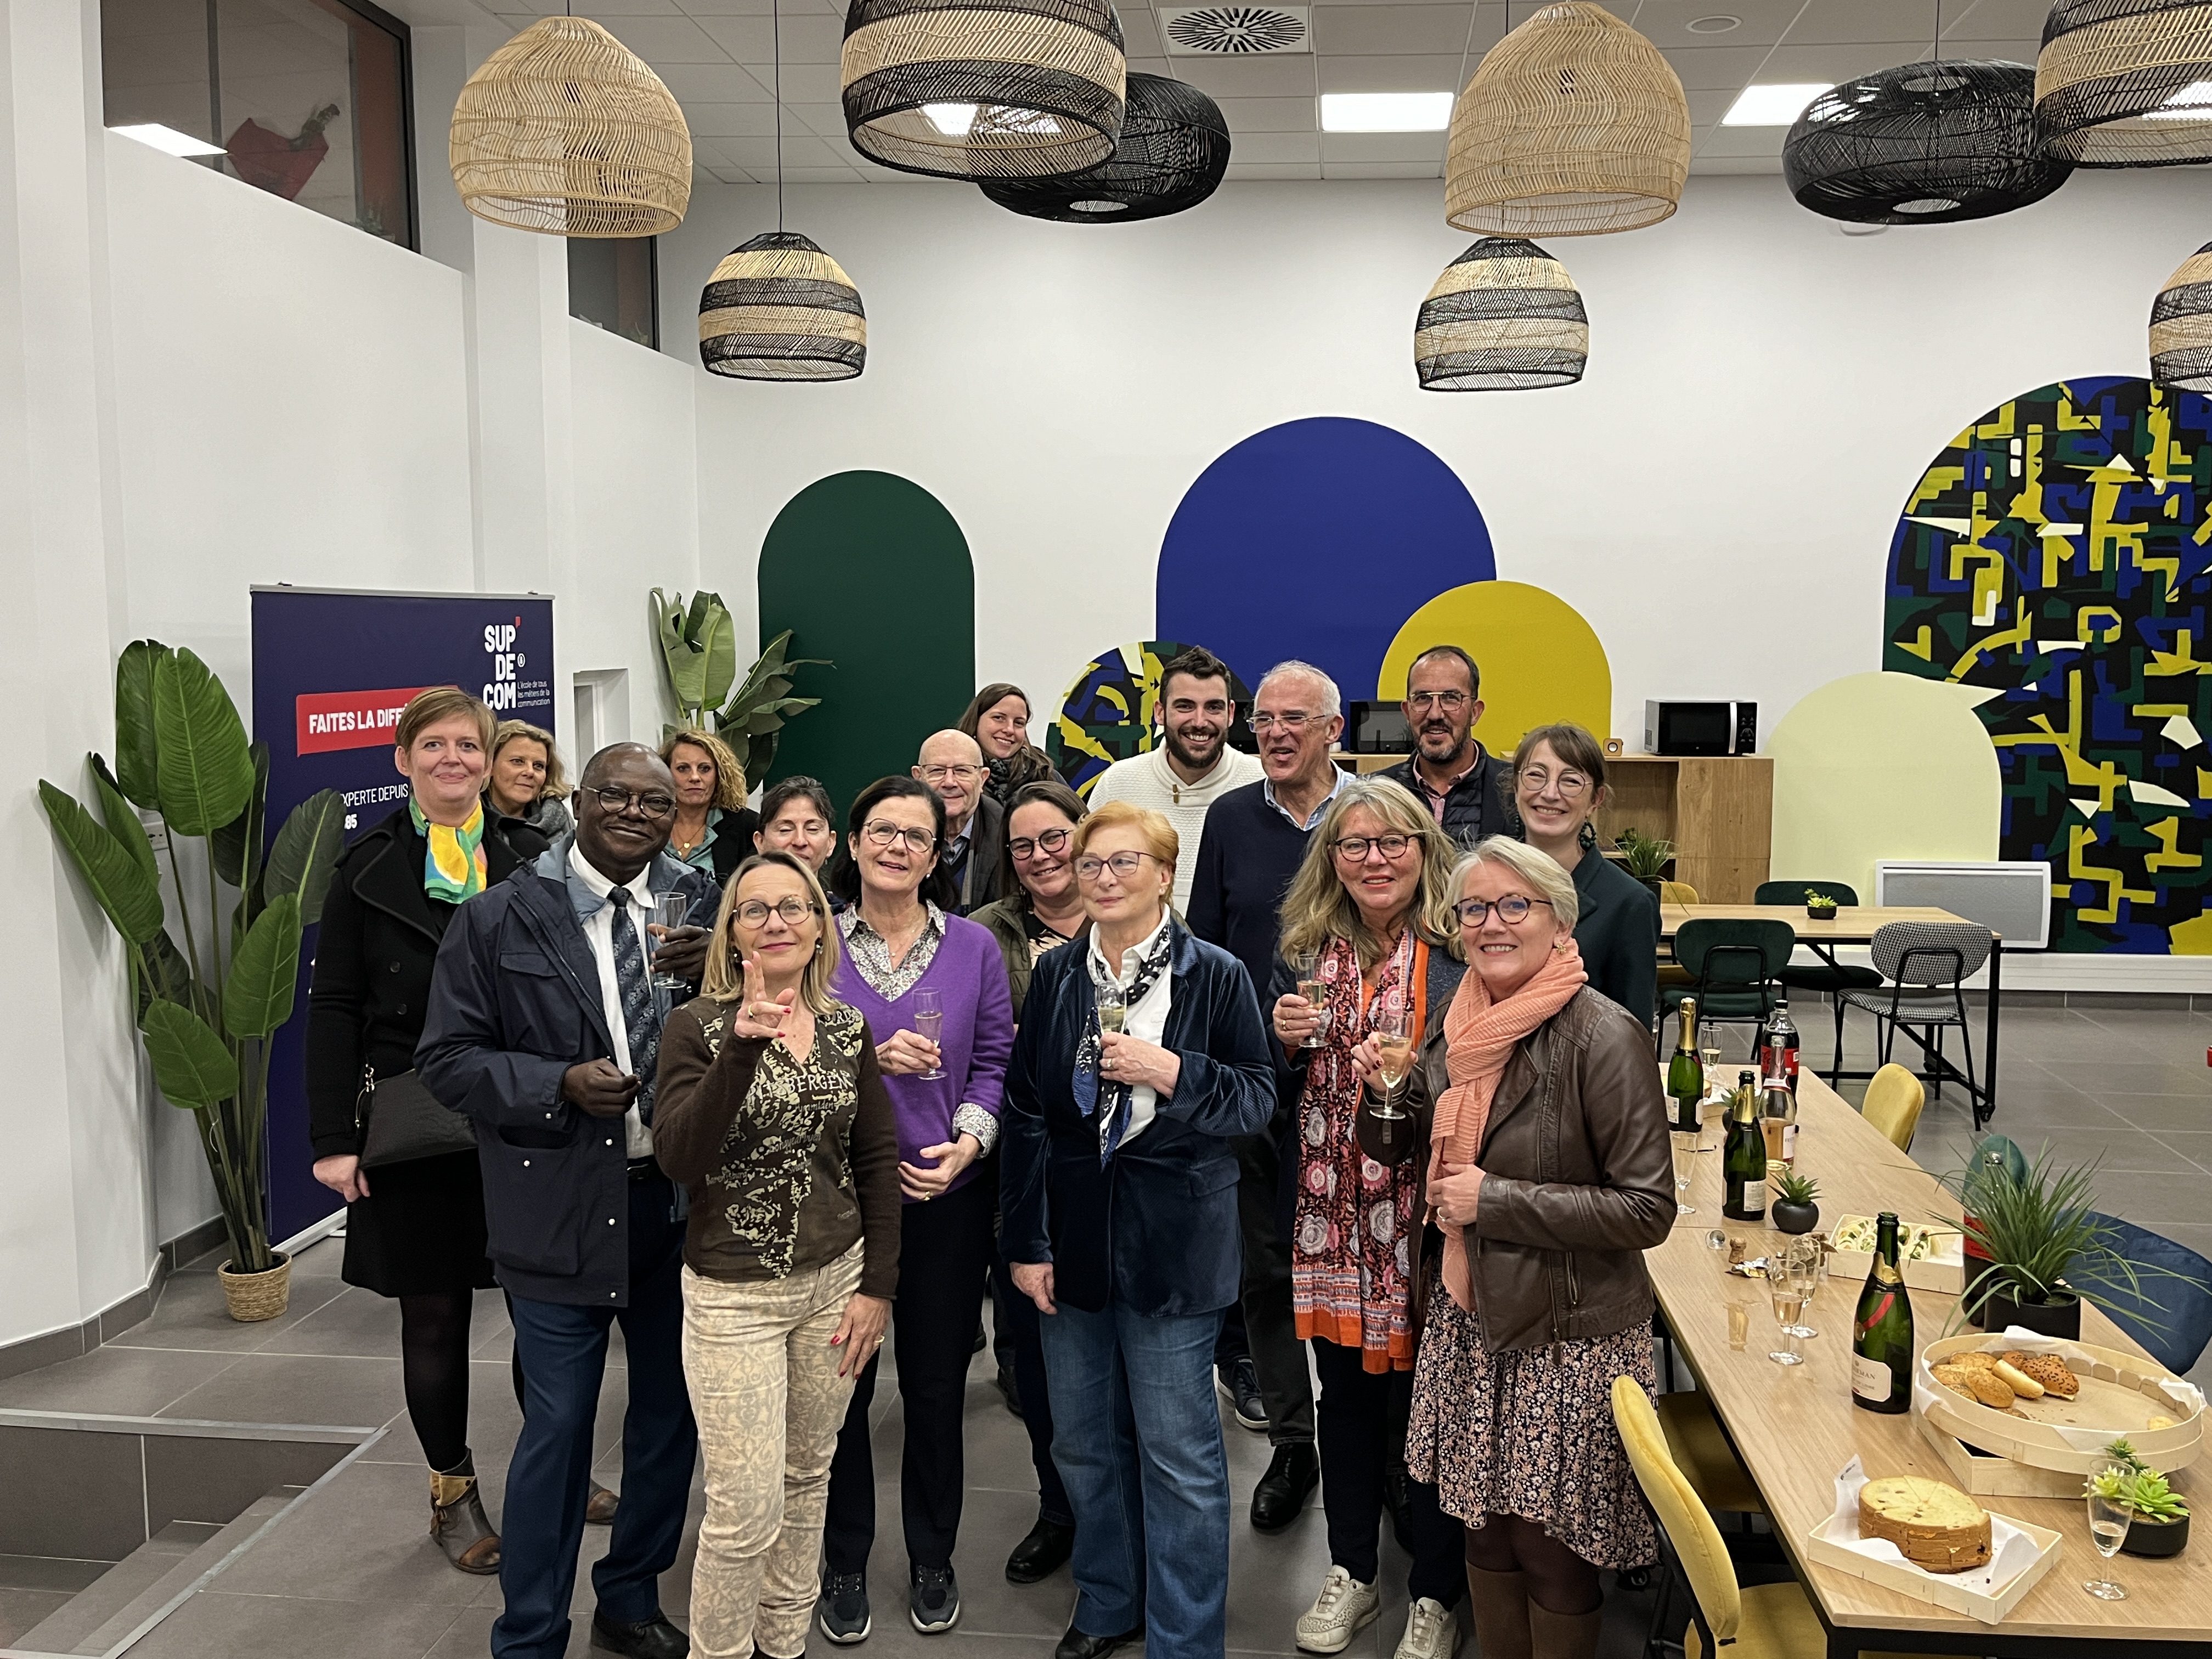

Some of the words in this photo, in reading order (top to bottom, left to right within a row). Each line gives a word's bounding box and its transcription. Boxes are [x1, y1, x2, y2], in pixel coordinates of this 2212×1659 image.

[495, 653, 516, 681] DE
[483, 681, 516, 710] COM
[517, 698, 551, 708] communication
[309, 712, 356, 734] FAITES
[357, 710, 375, 730] LA
[340, 788, 377, 807] XPERTE
[378, 783, 409, 802] DEPUIS
[344, 813, 358, 830] 85
[745, 1070, 854, 1101] PITSBERGEN
